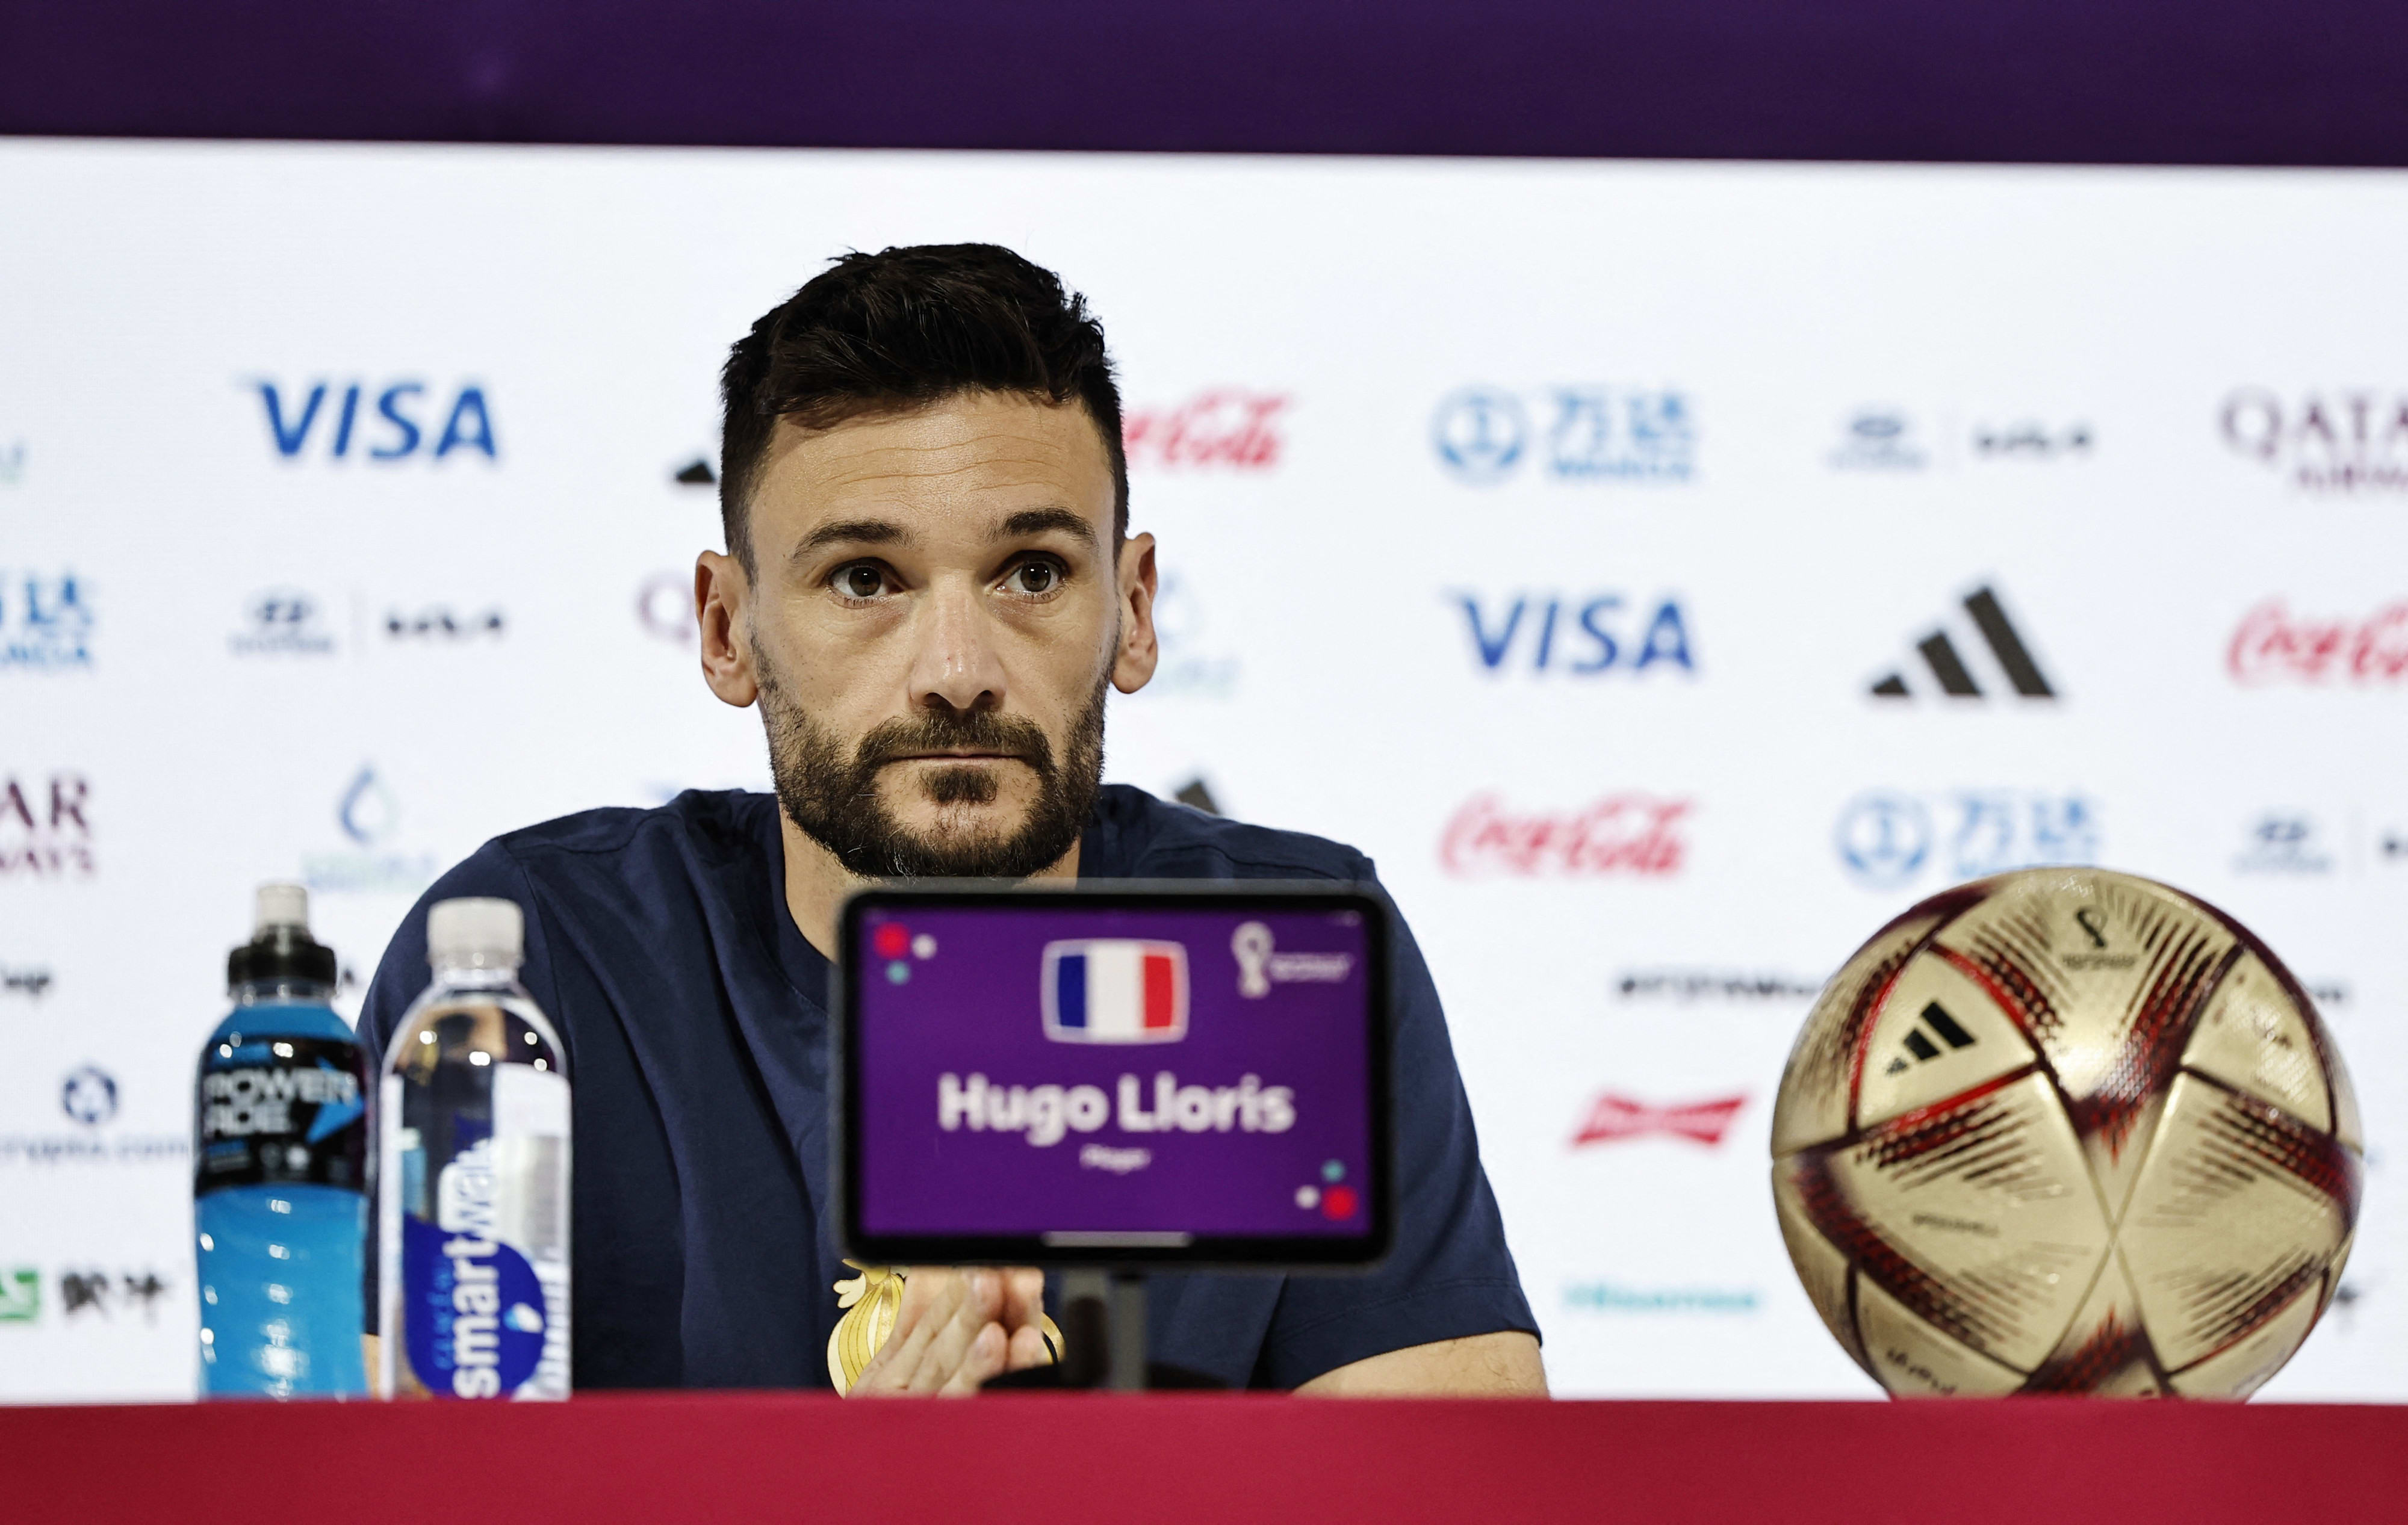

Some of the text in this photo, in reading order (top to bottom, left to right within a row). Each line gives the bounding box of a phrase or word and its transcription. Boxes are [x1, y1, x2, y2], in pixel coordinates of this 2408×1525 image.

[246, 380, 500, 460] VISA
[2217, 388, 2408, 462] QATA
[1446, 591, 1698, 673] VISA
[937, 1070, 1297, 1147] Hugo Lloris
